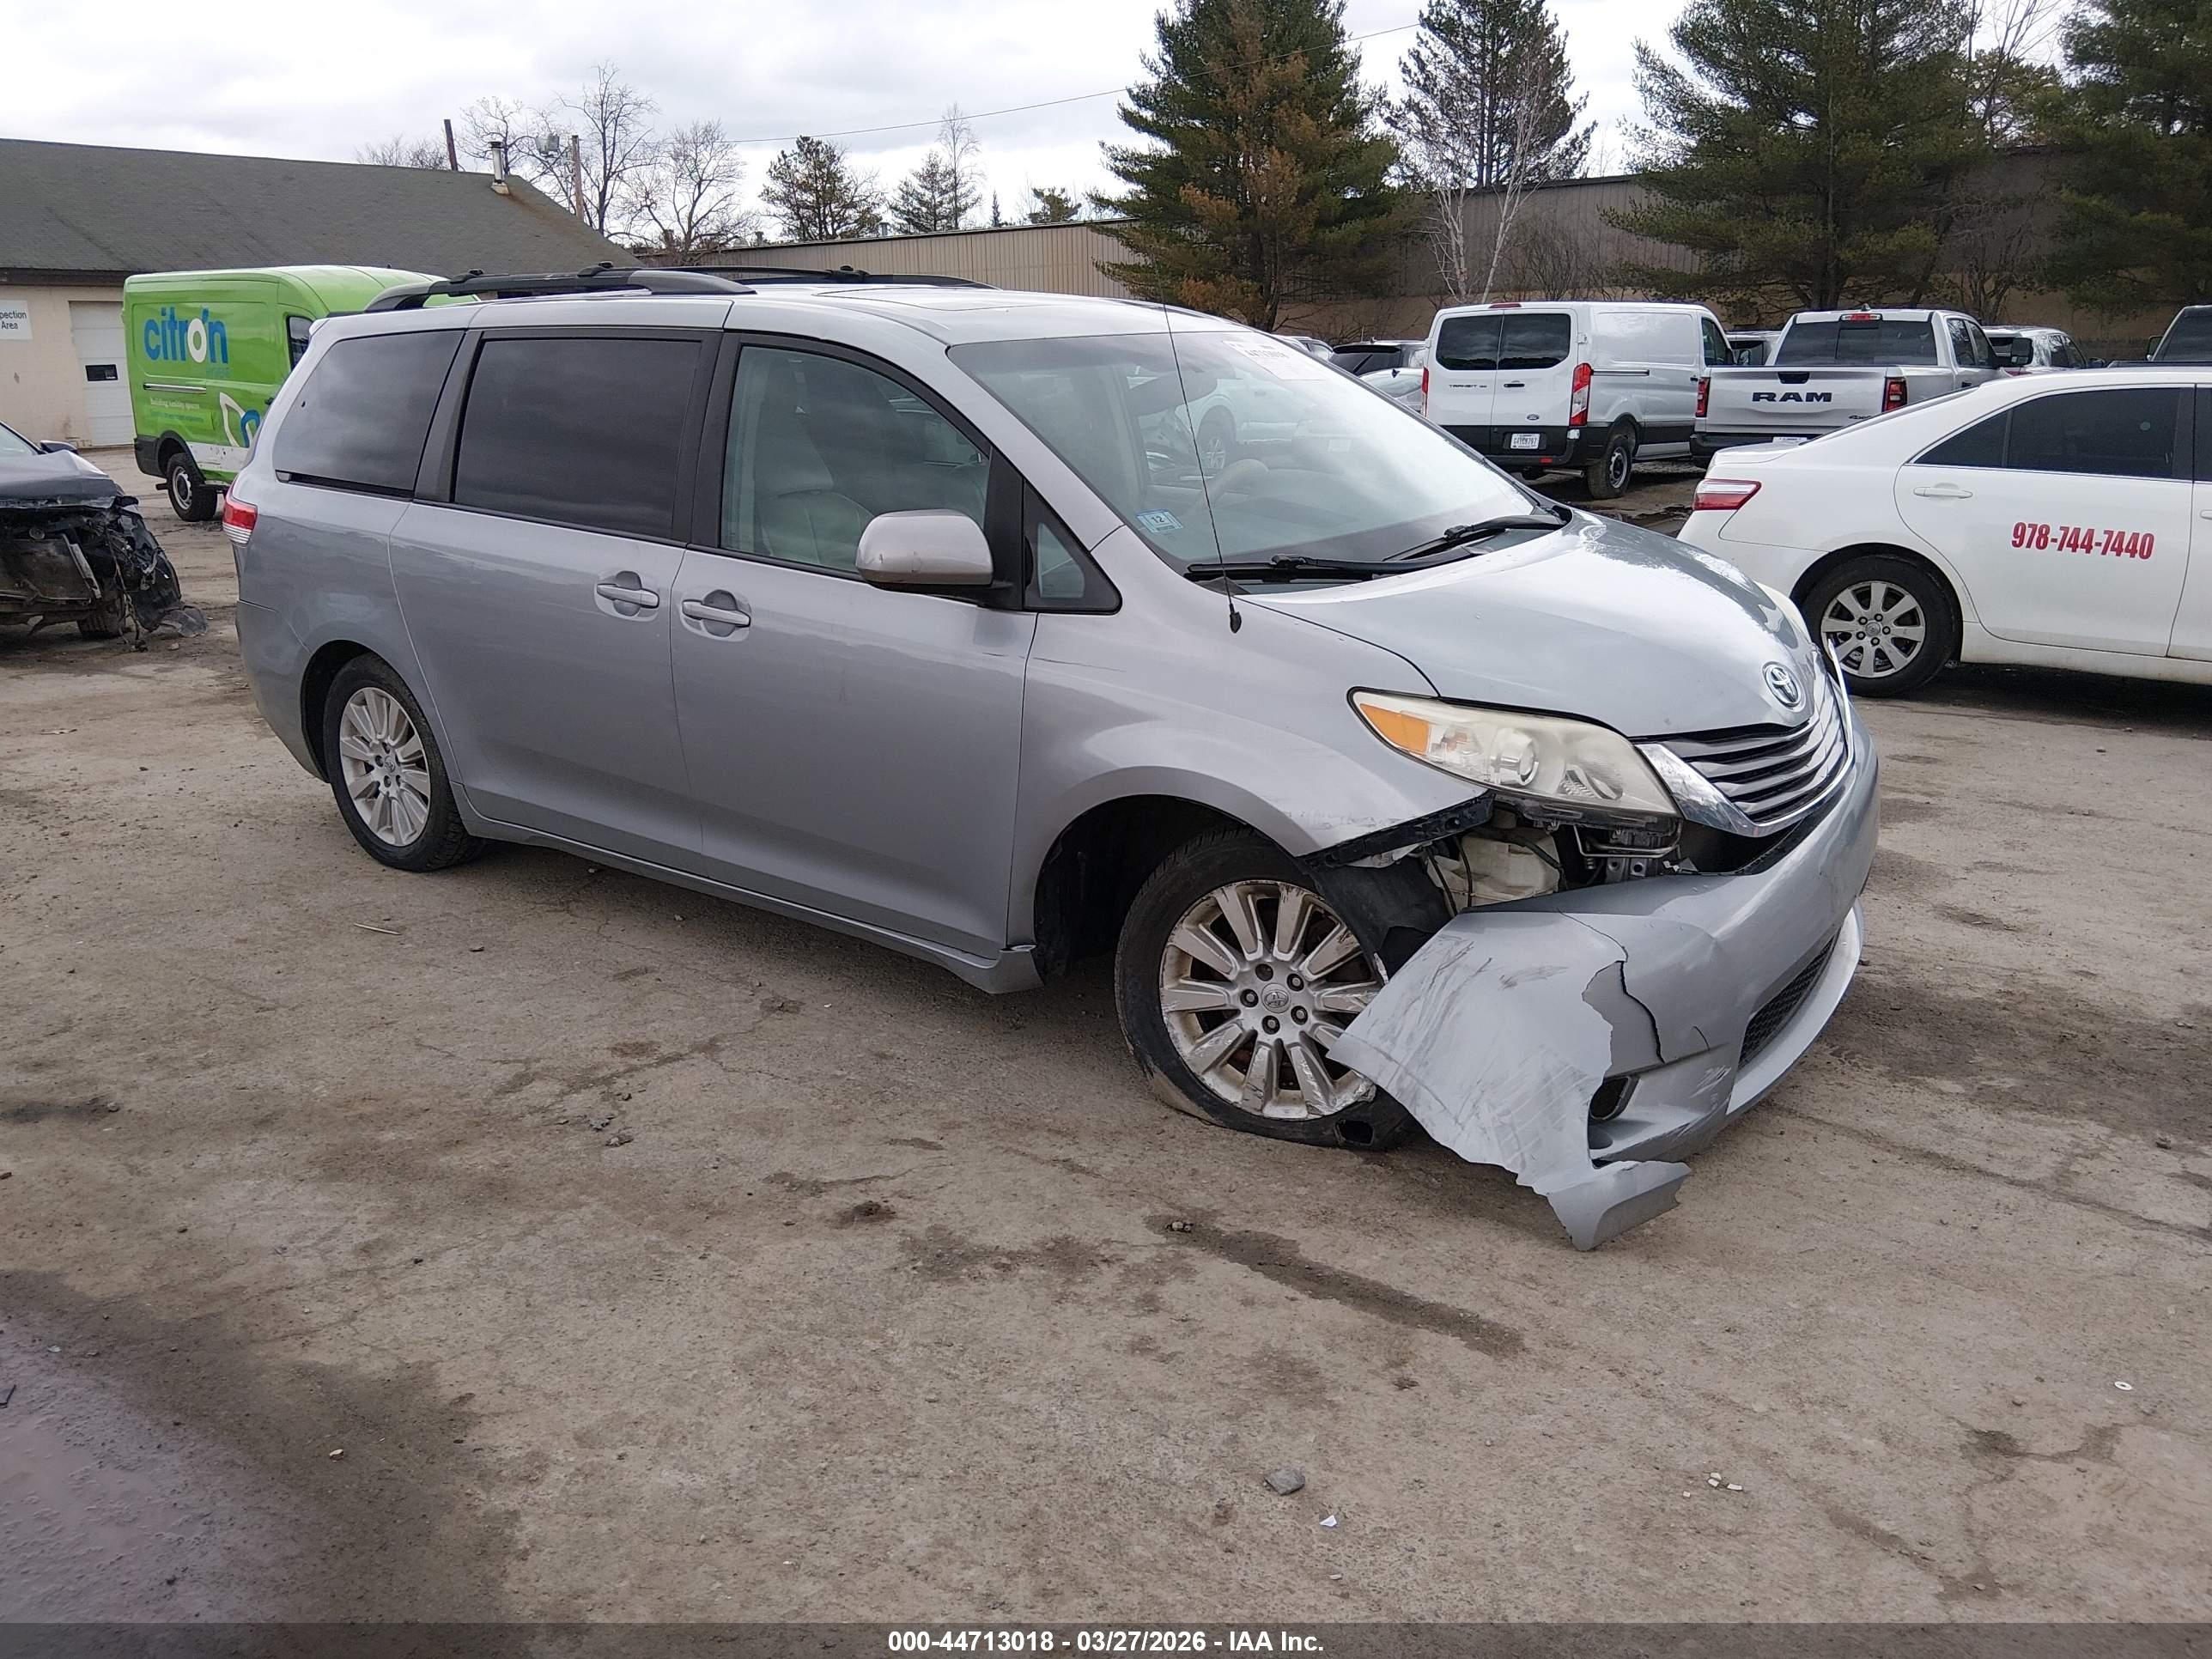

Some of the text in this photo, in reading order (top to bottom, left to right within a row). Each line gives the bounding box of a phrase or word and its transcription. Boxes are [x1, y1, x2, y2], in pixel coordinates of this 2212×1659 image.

[2, 320, 18, 330] Area
[1752, 392, 1832, 403] RAM
[1151, 515, 1164, 524] 12
[2011, 522, 2155, 560] 978-744-7440
